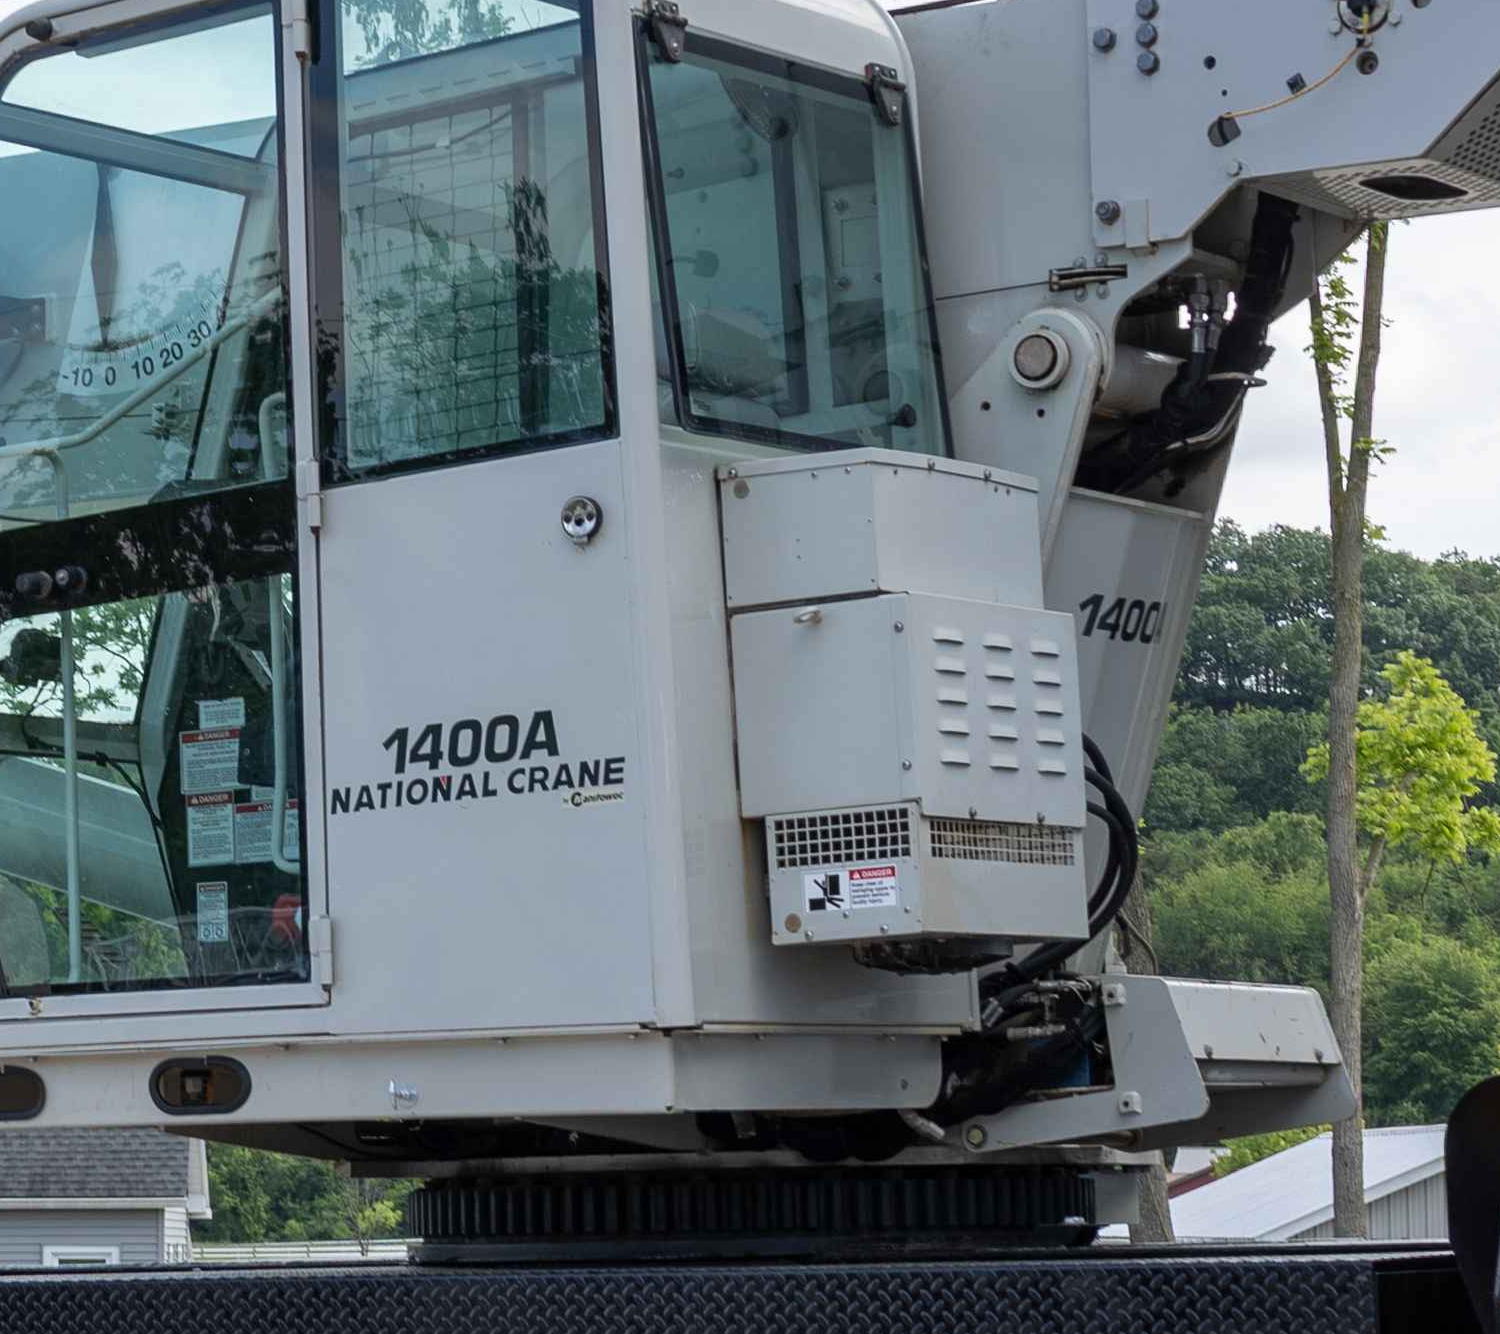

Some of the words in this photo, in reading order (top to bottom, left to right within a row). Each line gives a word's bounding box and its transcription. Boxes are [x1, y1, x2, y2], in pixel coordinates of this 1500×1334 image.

[105, 367, 116, 386] 0
[131, 356, 154, 379] 10
[159, 342, 183, 368] 20
[187, 320, 212, 348] 30
[1079, 593, 1167, 643] 1400
[382, 710, 560, 774] 1400A
[331, 771, 498, 814] NATIONAL
[507, 757, 625, 794] CRANE
